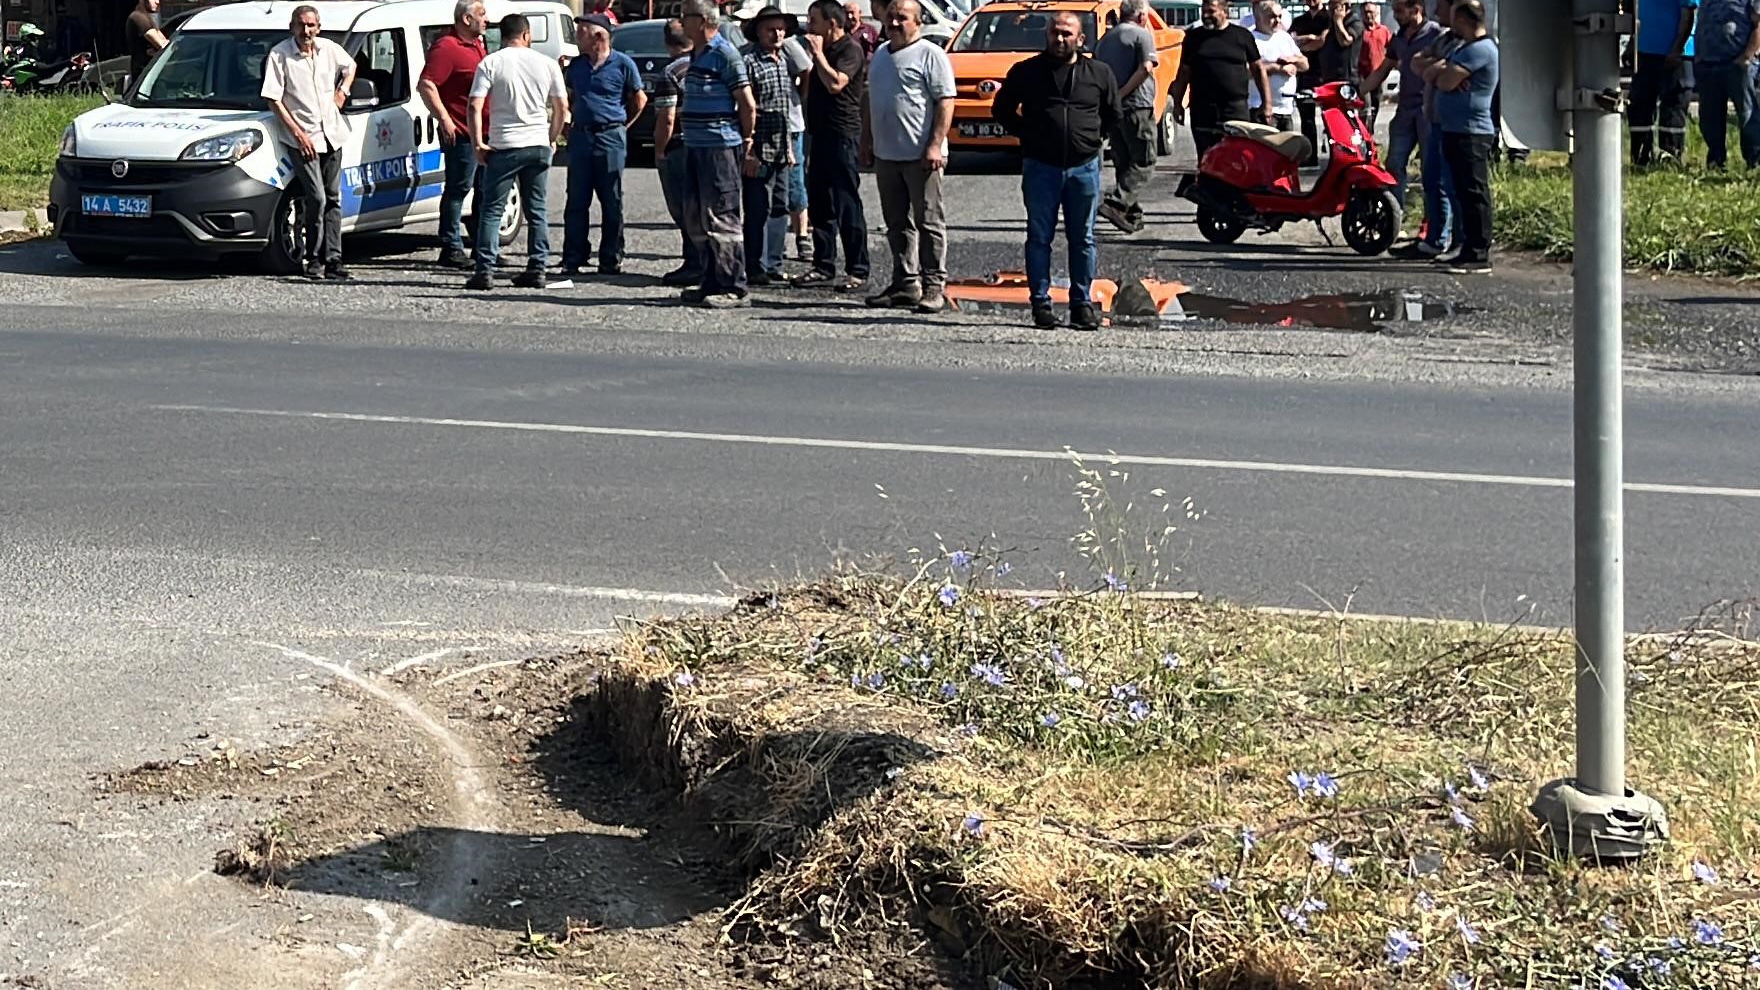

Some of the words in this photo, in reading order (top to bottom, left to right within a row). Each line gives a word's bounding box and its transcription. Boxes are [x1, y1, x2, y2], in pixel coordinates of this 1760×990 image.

[85, 197, 99, 211] 14
[102, 199, 112, 212] A
[119, 199, 147, 213] 5432
